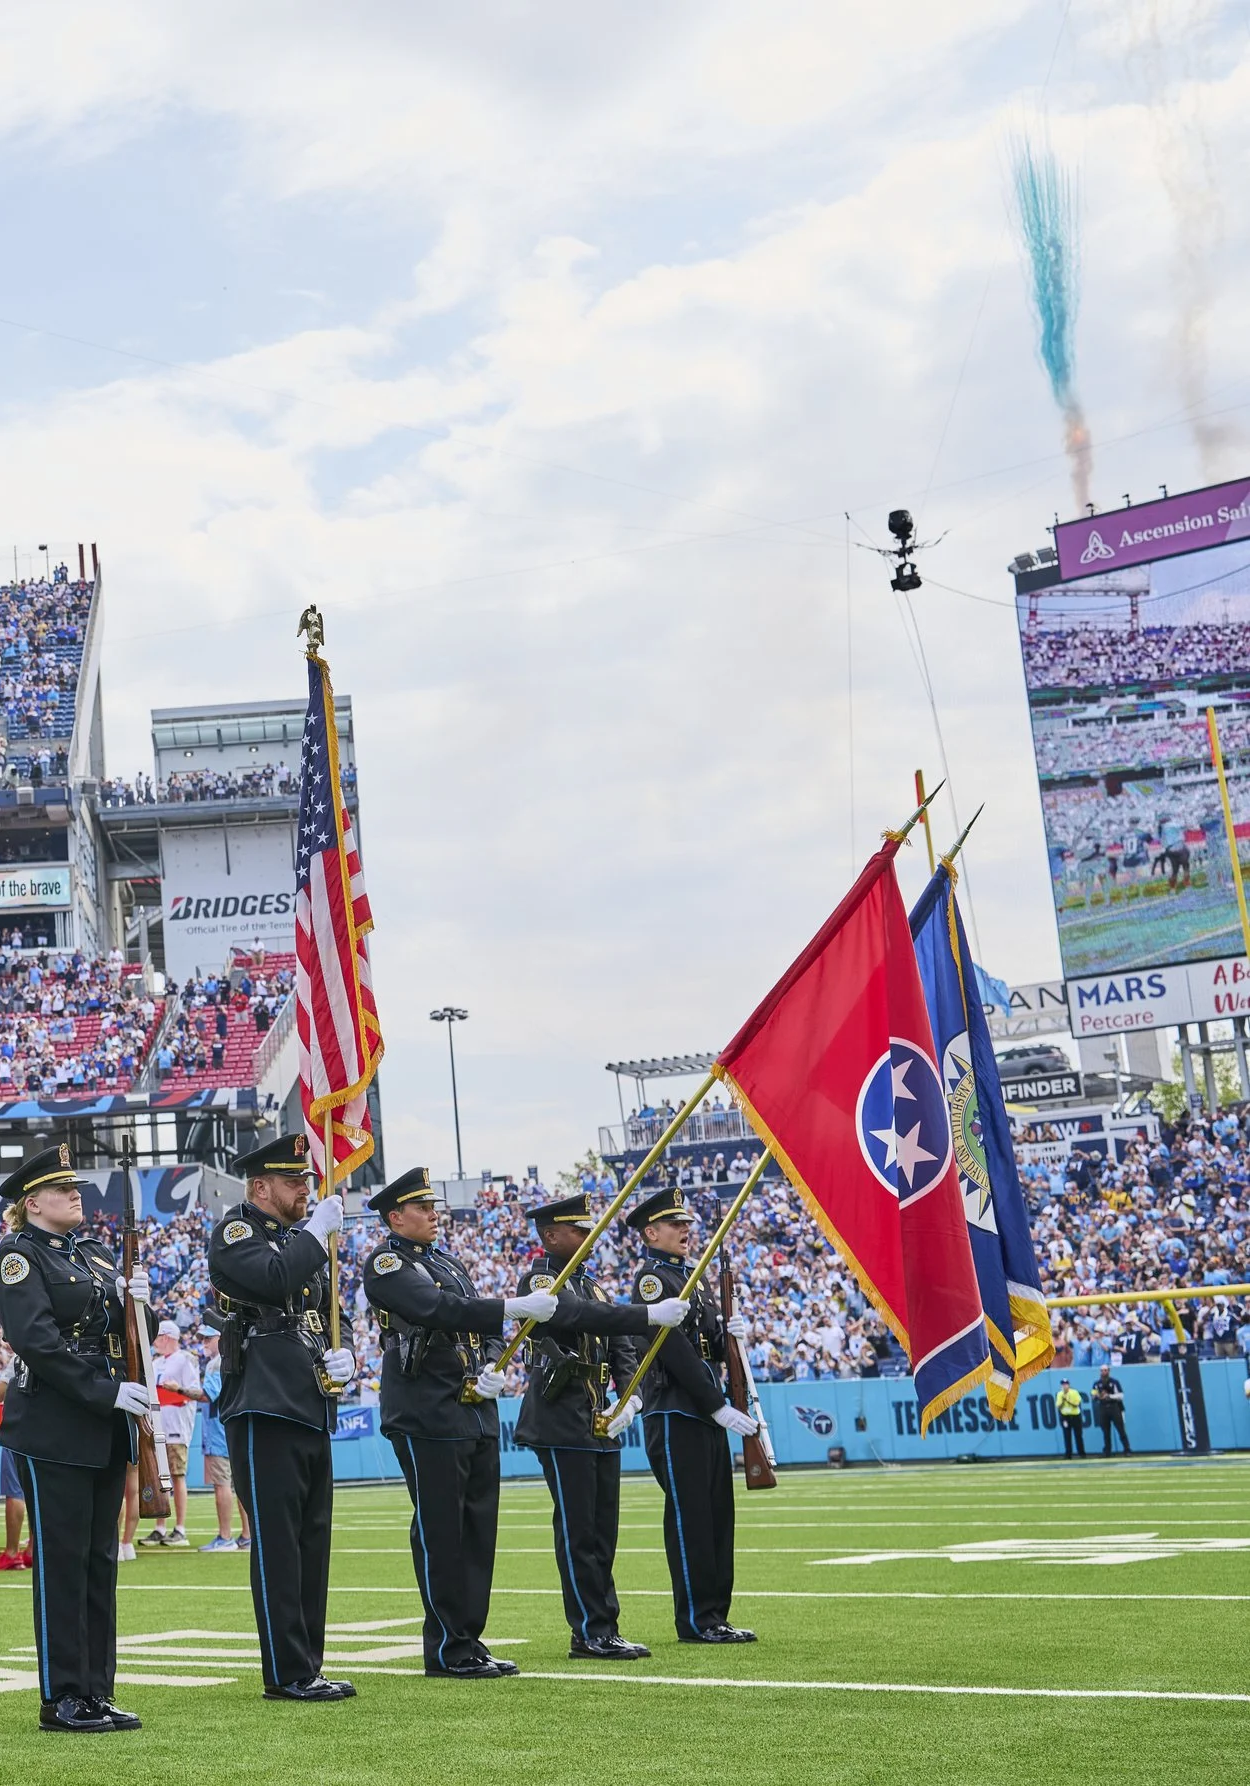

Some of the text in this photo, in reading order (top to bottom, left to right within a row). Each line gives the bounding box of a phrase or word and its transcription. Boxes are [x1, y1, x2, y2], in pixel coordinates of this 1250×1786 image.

[1119, 515, 1214, 548] Ascension
[9, 880, 27, 896] the
[30, 879, 61, 895] brave
[186, 924, 219, 935] Official
[221, 923, 238, 933] Tire
[240, 922, 250, 932] of
[251, 921, 267, 932] the
[1214, 964, 1227, 985] A
[1077, 974, 1167, 1008] MARS
[1081, 1011, 1154, 1032] Petcare
[952, 1085, 970, 1143] NASHVILLE
[956, 1144, 970, 1164] AND
[1119, 1334, 1137, 1350] 77
[1174, 1359, 1197, 1449] TITANS
[343, 1415, 368, 1430] NFL
